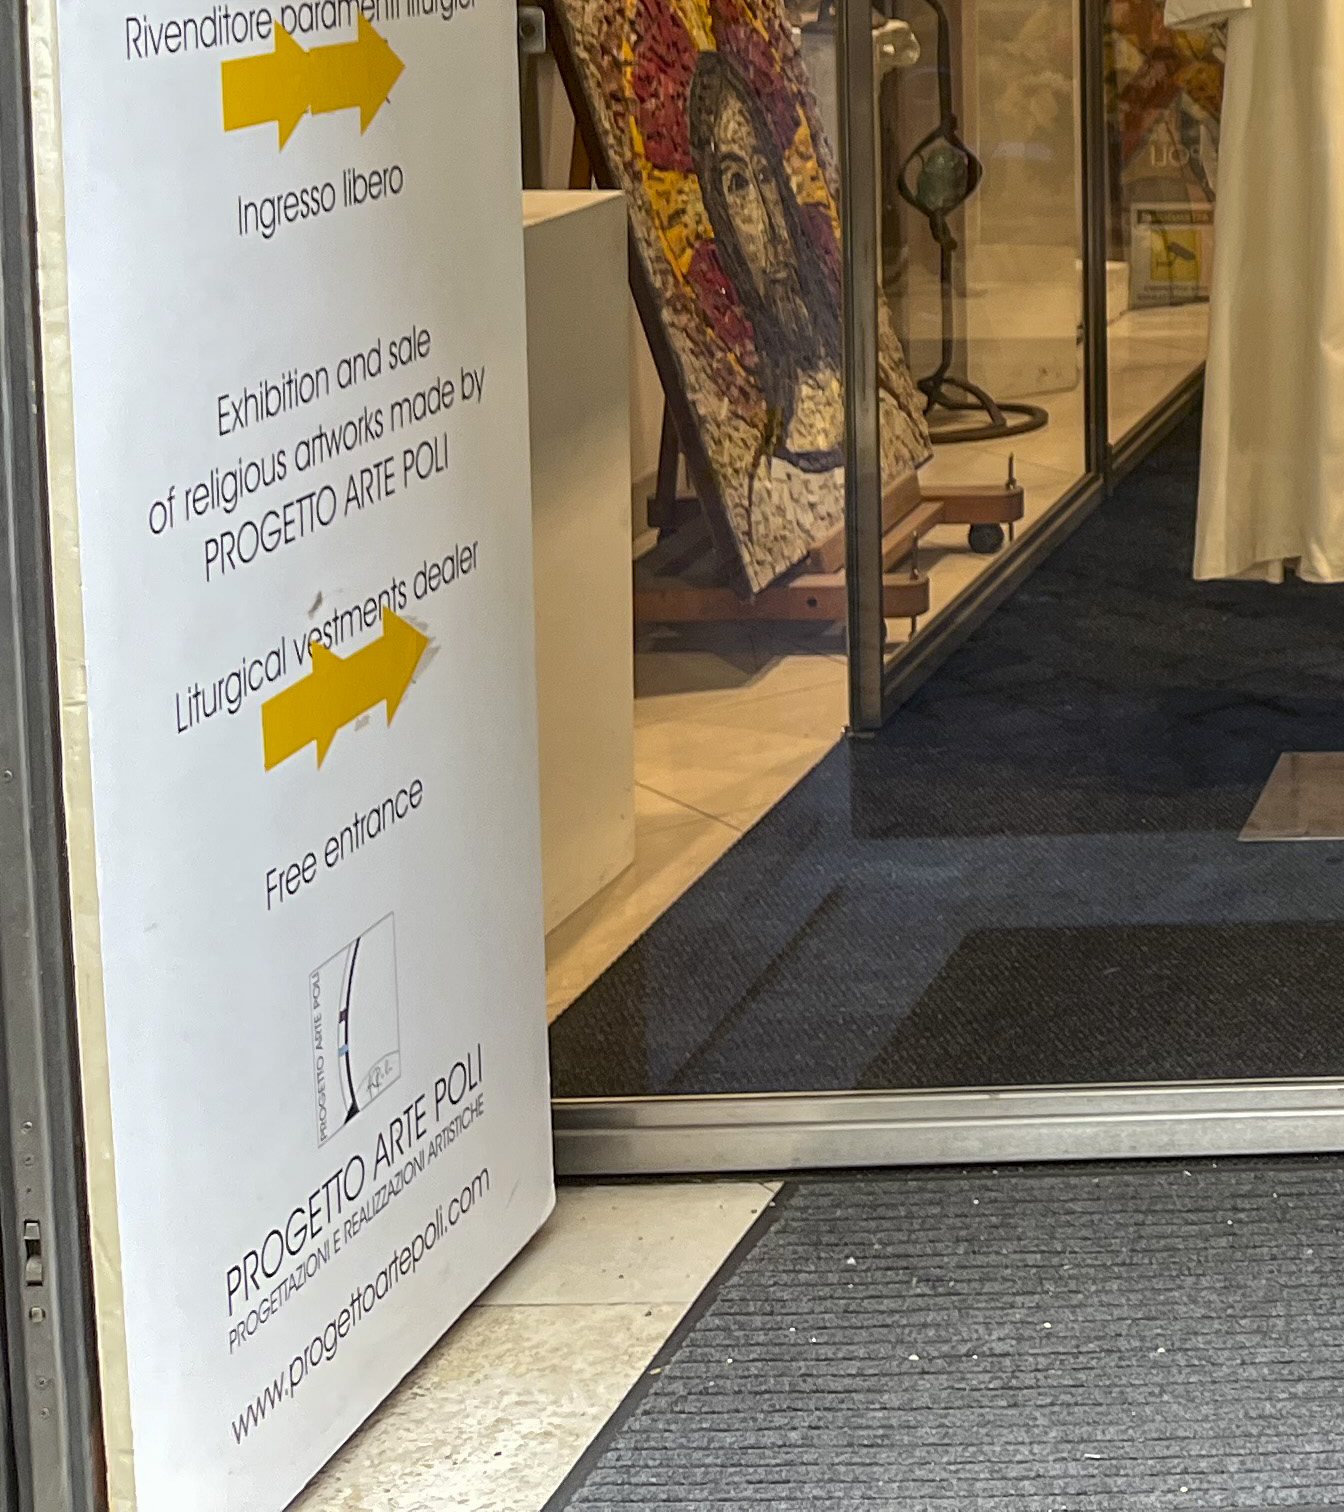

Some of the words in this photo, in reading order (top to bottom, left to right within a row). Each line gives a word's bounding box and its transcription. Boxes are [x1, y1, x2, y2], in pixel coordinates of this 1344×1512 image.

[126, 0, 273, 60] Rivenditore
[239, 184, 336, 239] Ingresso
[344, 163, 403, 210] libero
[149, 487, 176, 536] of
[185, 449, 287, 522] religious
[295, 407, 383, 474] artworks
[390, 379, 455, 431] made
[460, 366, 486, 405] by
[218, 367, 329, 437] Exhibition
[337, 340, 382, 390] and
[389, 324, 431, 369] sale
[204, 484, 337, 583] PROGETTO
[344, 463, 396, 518] ARTE
[403, 432, 450, 489] POLI
[175, 636, 286, 734] Liturgical
[293, 576, 407, 666] vestments
[413, 540, 479, 600] dealer
[265, 850, 317, 911] Free
[324, 778, 423, 867] entrance
[315, 1055, 328, 1142] PROGETTO
[226, 1155, 365, 1317] PROGETTO
[373, 1094, 426, 1181] ARTE
[435, 1043, 482, 1122] POLI
[229, 1242, 330, 1354] PROGETTAZIONI
[333, 1229, 341, 1255] E
[344, 1155, 425, 1244] REALIZZAZIONI
[428, 1093, 484, 1165] ARTISTICHE
[231, 1168, 490, 1445] www.progettoartepoli.com
